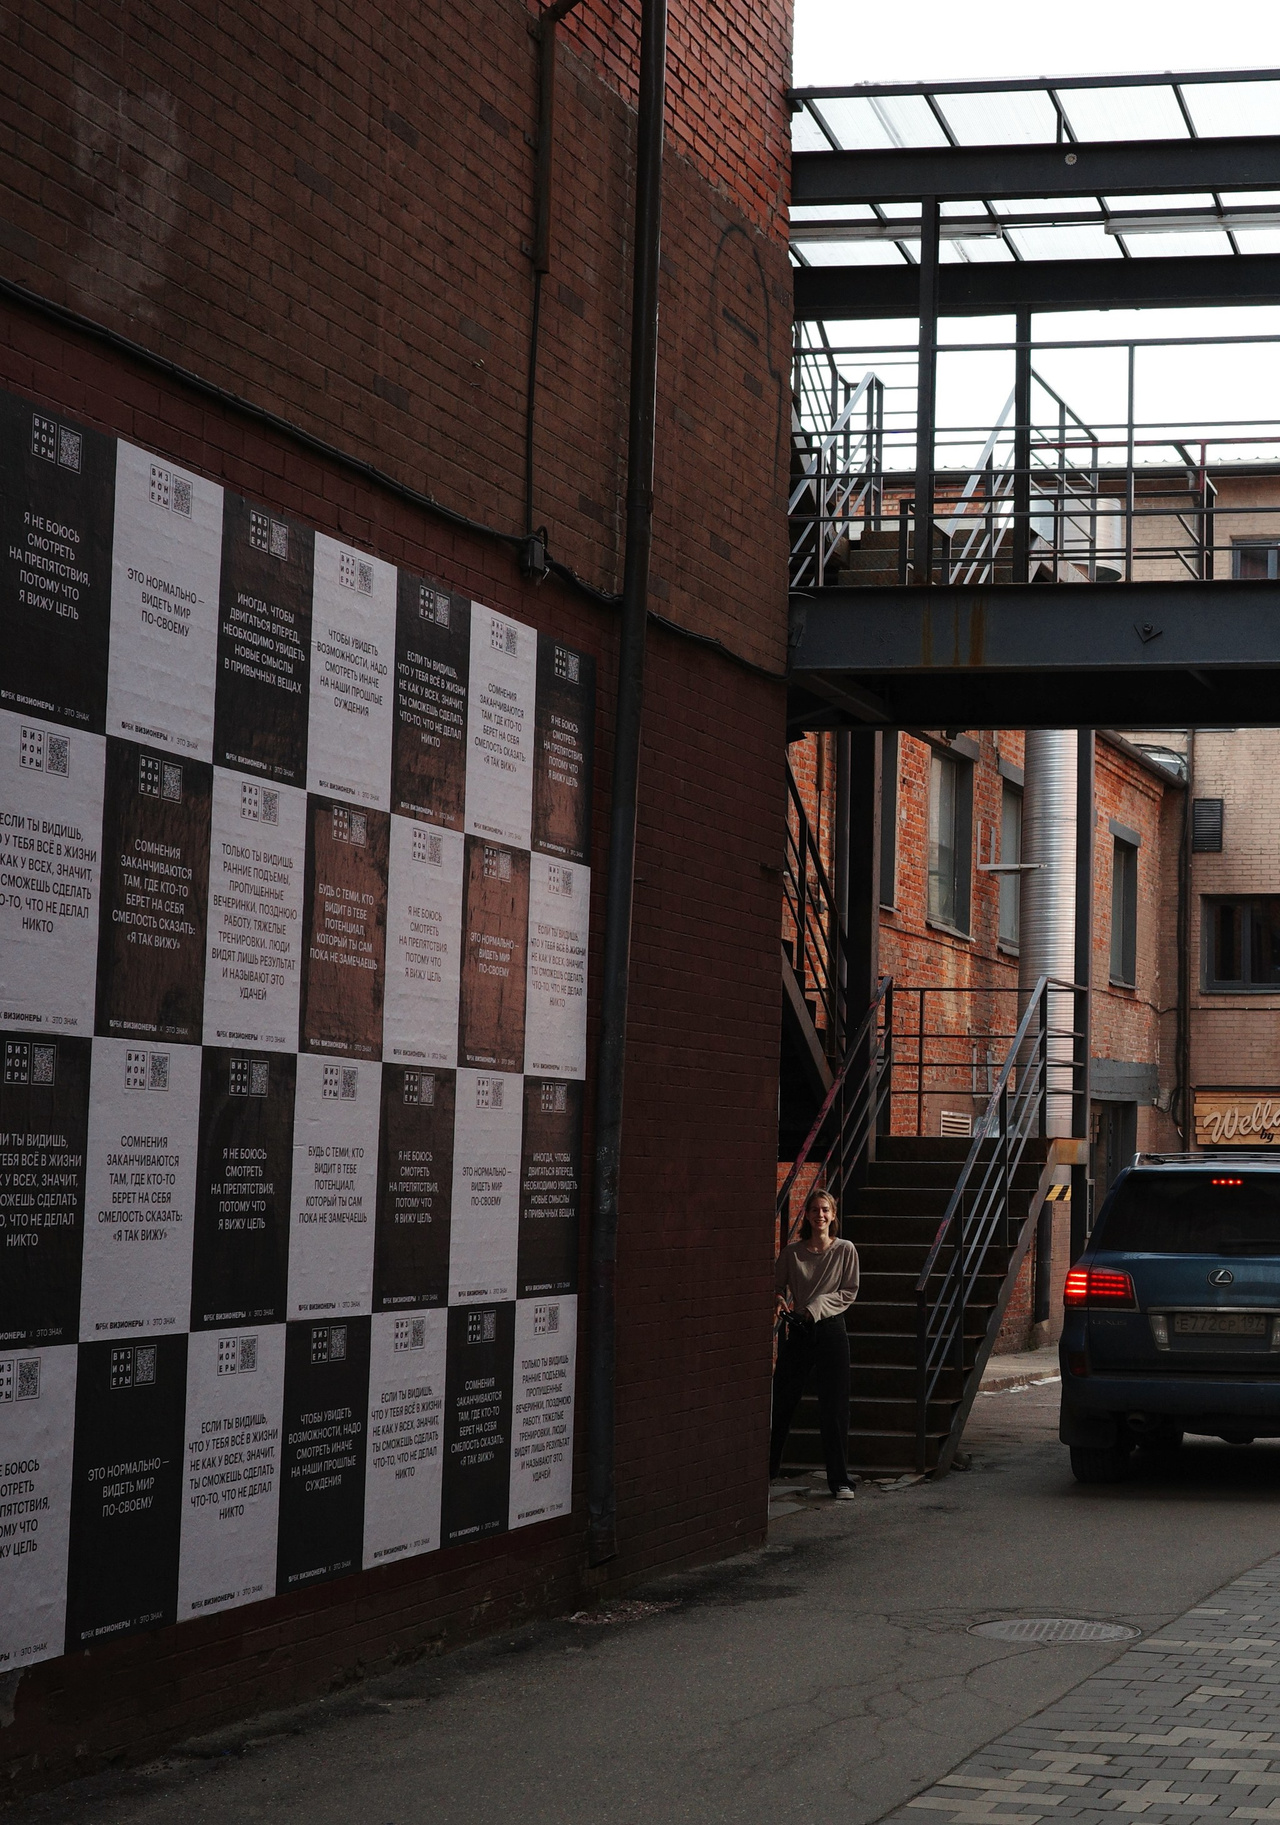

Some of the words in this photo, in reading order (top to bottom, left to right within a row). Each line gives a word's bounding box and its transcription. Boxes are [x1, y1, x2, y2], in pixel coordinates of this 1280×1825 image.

[23, 511, 30, 524] Я
[31, 514, 44, 530] НЕ
[45, 519, 80, 543] БОЮСЬ
[27, 532, 75, 561] СМОТРЕТЬ
[9, 545, 23, 561] НА
[24, 550, 90, 587] ПРЕПЯТСТВИЯ,
[19, 569, 60, 593] ПОТОМУ
[61, 583, 79, 601] ЧТО
[127, 567, 145, 584] ЭТО
[145, 574, 197, 604] НОРМАЛЬНО
[18, 588, 25, 602] Я
[26, 591, 54, 611] ВИЖУ
[55, 601, 79, 620] ЦЕЛЬ
[141, 591, 172, 613] ВИДЕТЬ
[173, 603, 191, 619] МИР
[237, 592, 269, 615] ИНОГДА,
[270, 605, 294, 624] ЧТОБЫ
[141, 609, 190, 637] ПО-СВОЕМУ
[229, 606, 271, 632] ДВИГАТЬСЯ
[271, 622, 300, 644] ВПЕРЕД,
[222, 621, 274, 650] НЕОБХОДИМО
[275, 640, 305, 662] УВИДЕТЬ
[328, 628, 350, 646] ЧТОБЫ
[351, 637, 378, 656] УВИДЕТЬ
[234, 643, 260, 663] НОВЫЕ
[260, 653, 294, 674] СМЫСЛЫ
[316, 640, 369, 670] ВОЗМОЖНОСТИ,
[369, 660, 388, 676] НАДО
[224, 657, 230, 669] В
[230, 659, 276, 685] ПРИВЫЧНЫХ
[277, 675, 302, 694] ВЕЩАХ
[324, 660, 358, 681] СМОТРЕТЬ
[358, 672, 379, 689] ИНАЧЕ
[16, 693, 54, 711] ВИЗИОНЕРЫ
[319, 675, 329, 687] НА
[330, 678, 350, 694] НАШИ
[351, 685, 383, 706] ПРОШЛЫЕ
[333, 696, 369, 716] СУЖДЕНИЯ
[134, 724, 168, 741] ВИЗИОНЕРЫ
[134, 838, 181, 860] СОМНЕНИЯ
[221, 842, 250, 859] ТОЛЬКО
[251, 849, 262, 862] ТЫ
[262, 852, 293, 869] ВИДИШЬ
[120, 854, 192, 880] ЗАКАНЧИВАЮТСЯ
[222, 860, 252, 877] РАННИЕ
[252, 867, 290, 886] ПОДЪЕМЫ,
[123, 873, 142, 889] ТАМ,
[144, 877, 159, 892] ГДЕ
[160, 881, 189, 897] КТО-ТО
[228, 879, 284, 901] ПРОПУЩЕННЫЕ
[125, 892, 150, 908] БЕРЕТ
[151, 897, 163, 911] НА
[164, 900, 184, 914] СЕБЯ
[213, 894, 257, 915] ВЕЧЕРИНКИ,
[258, 902, 298, 920] ПОЗДНЮЮ
[111, 908, 157, 928] СМЕЛОСТЬ
[158, 917, 195, 934] СКАЗАТЬ:
[223, 914, 252, 932] РАБОТУ,
[253, 918, 286, 935] ТЯЖЕЛЫЕ
[126, 931, 136, 943] «Я
[137, 932, 153, 946] ТАК
[154, 935, 180, 950] ВИЖУ»
[218, 930, 267, 949] ТРЕНИРОВКИ.
[268, 939, 290, 953] ЛЮДИ
[211, 947, 236, 962] ВИДЯТ
[236, 951, 259, 965] ЛИШЬ
[259, 954, 296, 970] РЕЗУЛЬТАТ
[222, 966, 228, 978] И
[229, 967, 270, 983] НАЗЫВАЮТ
[270, 973, 285, 986] ЭТО
[239, 986, 267, 1000] УДАЧЕЙ
[1260, 1129, 1274, 1143] by
[222, 1147, 228, 1159] Я
[228, 1147, 239, 1159] НЕ
[239, 1148, 267, 1160] БОЮСЬ
[308, 1145, 324, 1158] БУДЬ
[325, 1146, 331, 1157] С
[331, 1146, 350, 1158] ТЕМИ,
[351, 1147, 364, 1158] КТО
[225, 1165, 263, 1177] СМОТРЕТЬ
[314, 1162, 336, 1174] ВИДИТ
[337, 1163, 342, 1174] В
[342, 1163, 357, 1174] ТЕБЕ
[461, 1166, 473, 1176] ЭТО
[473, 1166, 506, 1177] НОРМАЛЬНО
[210, 1183, 222, 1194] НА
[222, 1182, 275, 1195] ПРЕПЯТСТВИЯ,
[314, 1178, 355, 1191] ПОТЕНЦИАЛ,
[470, 1181, 490, 1192] ВИДЕТЬ
[491, 1181, 503, 1191] МИР
[218, 1200, 251, 1212] ПОТОМУ
[251, 1200, 266, 1211] ЧТО
[305, 1195, 337, 1207] КОТОРЫЙ
[337, 1196, 347, 1207] ТЫ
[347, 1195, 362, 1206] САМ
[470, 1196, 502, 1206] ПО-СВОЕМУ
[217, 1218, 224, 1230] Я
[224, 1218, 246, 1230] ВИЖУ
[246, 1217, 266, 1230] ЦЕЛЬ
[298, 1212, 318, 1223] ПОКА
[318, 1212, 327, 1223] НЕ
[328, 1212, 367, 1223] ЗАМЕЧАЕШЬ
[201, 1419, 222, 1434] ЕСЛИ
[222, 1418, 234, 1430] ТЫ
[234, 1413, 268, 1429] ВИДИШЬ,
[188, 1440, 204, 1453] ЧТО
[205, 1439, 210, 1451] У
[211, 1436, 230, 1450] ТЕБЯ
[230, 1431, 245, 1447] ВСЁ
[245, 1432, 251, 1444] В
[251, 1428, 278, 1443] ЖИЗНИ
[189, 1458, 200, 1472] НЕ
[201, 1456, 216, 1469] КАК
[217, 1455, 223, 1467] У
[223, 1451, 245, 1466] ВСЕХ,
[246, 1445, 275, 1462] ЗНАЧИТ,
[189, 1477, 200, 1490] ТЫ
[201, 1469, 242, 1488] СМОЖЕШЬ
[242, 1463, 274, 1480] СДЕЛАТЬ
[190, 1491, 220, 1507] ЧТО-ТО,
[221, 1488, 237, 1501] ЧТО
[237, 1485, 247, 1498] НЕ
[247, 1480, 272, 1498] ДЕЛАЛ
[218, 1504, 244, 1520] НИКТО
